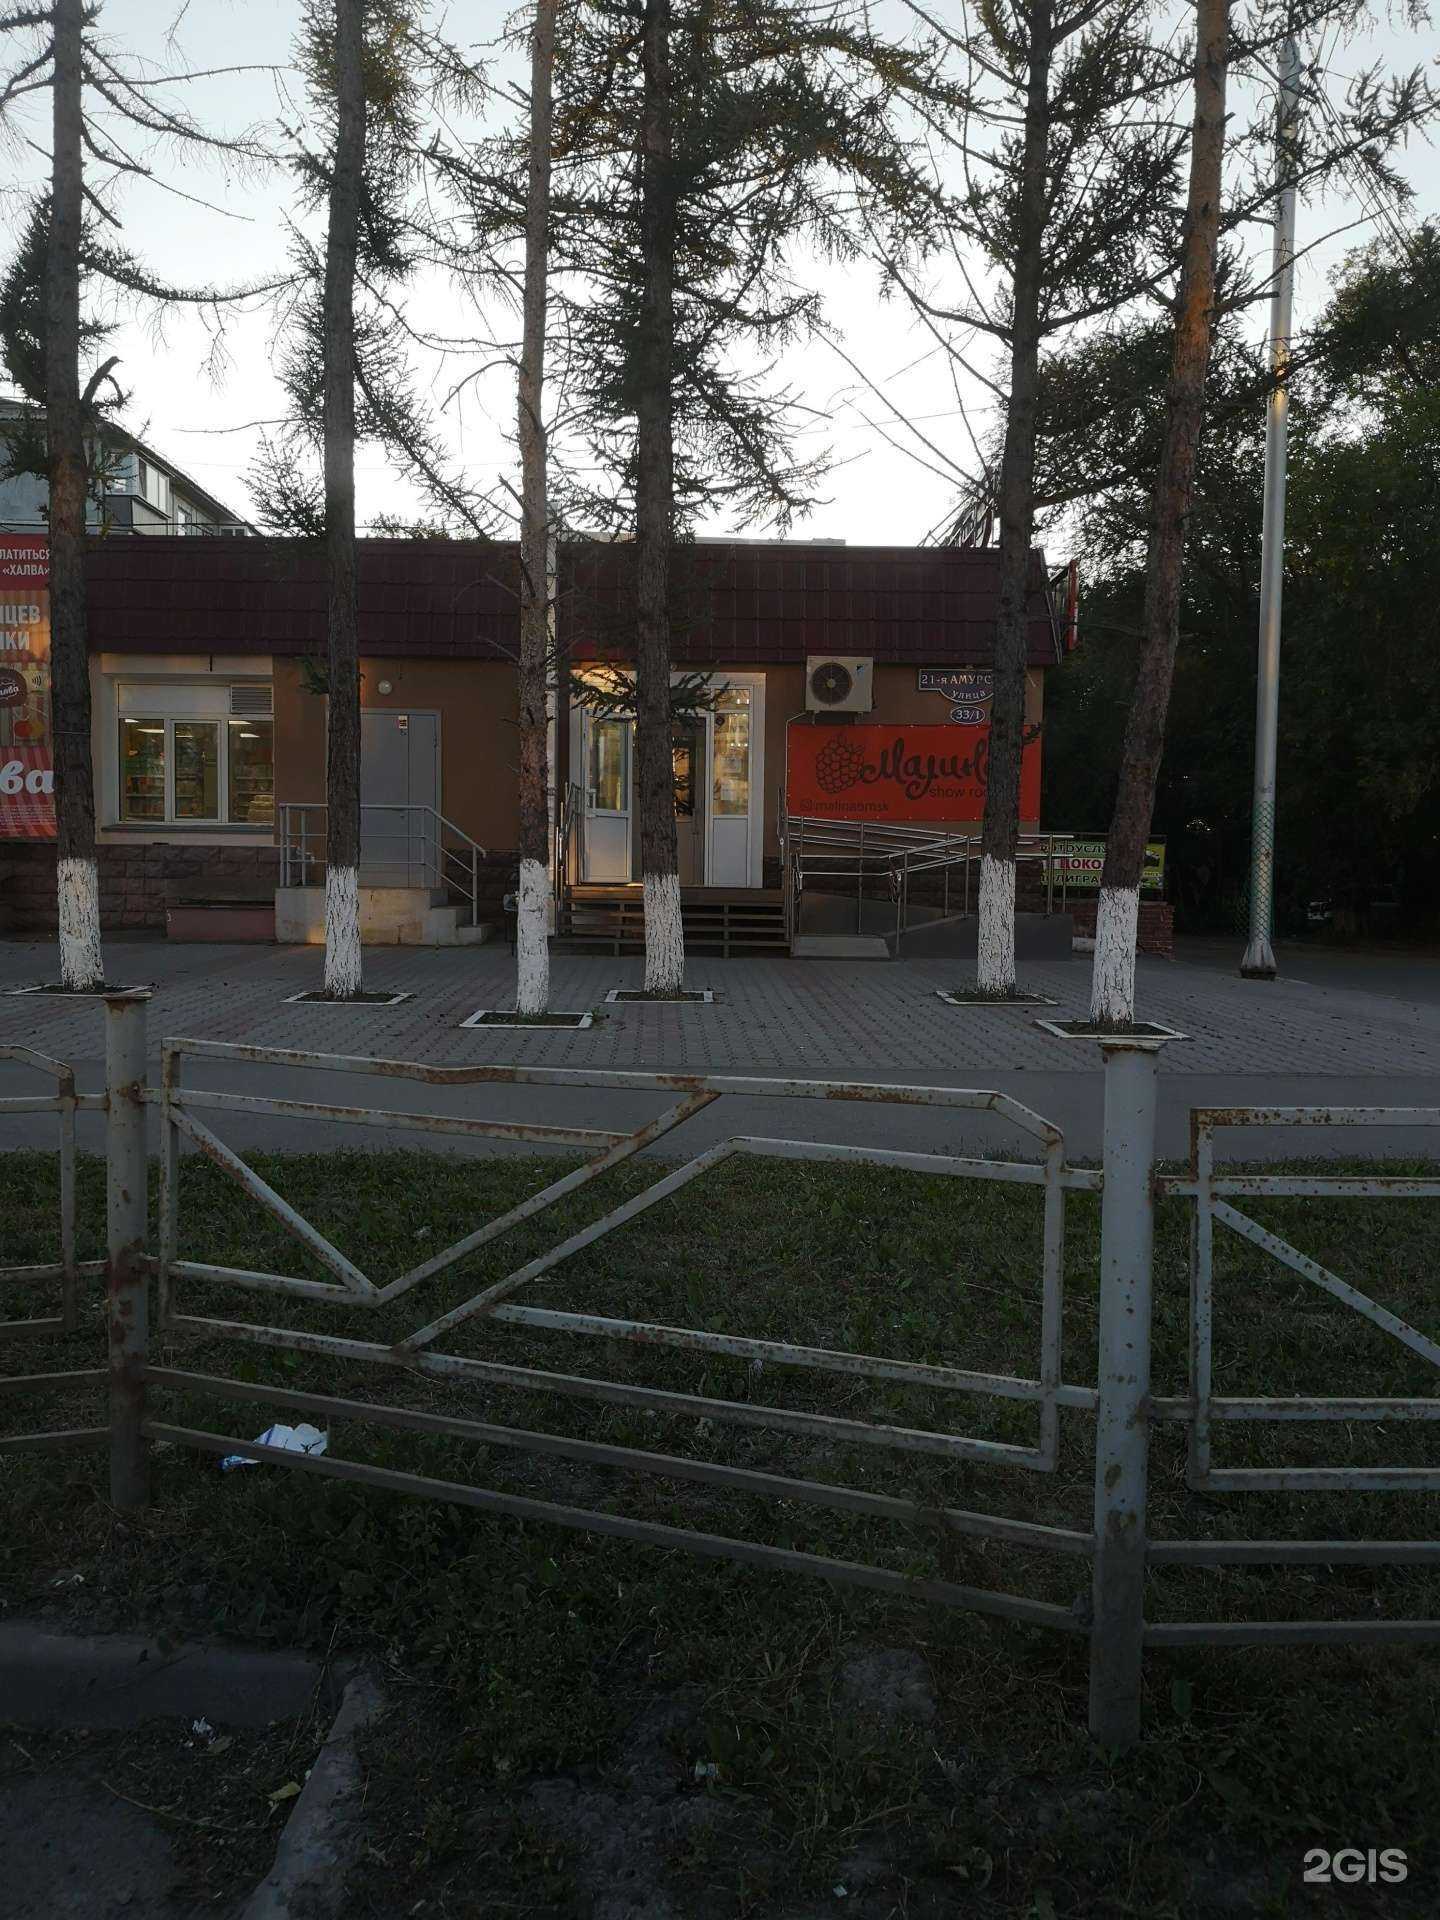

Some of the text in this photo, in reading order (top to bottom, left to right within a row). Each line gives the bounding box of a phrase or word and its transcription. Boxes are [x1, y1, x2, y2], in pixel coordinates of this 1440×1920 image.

[950, 674, 992, 685] АМУРС
[956, 709, 980, 720] 33/1
[929, 785, 966, 798] show
